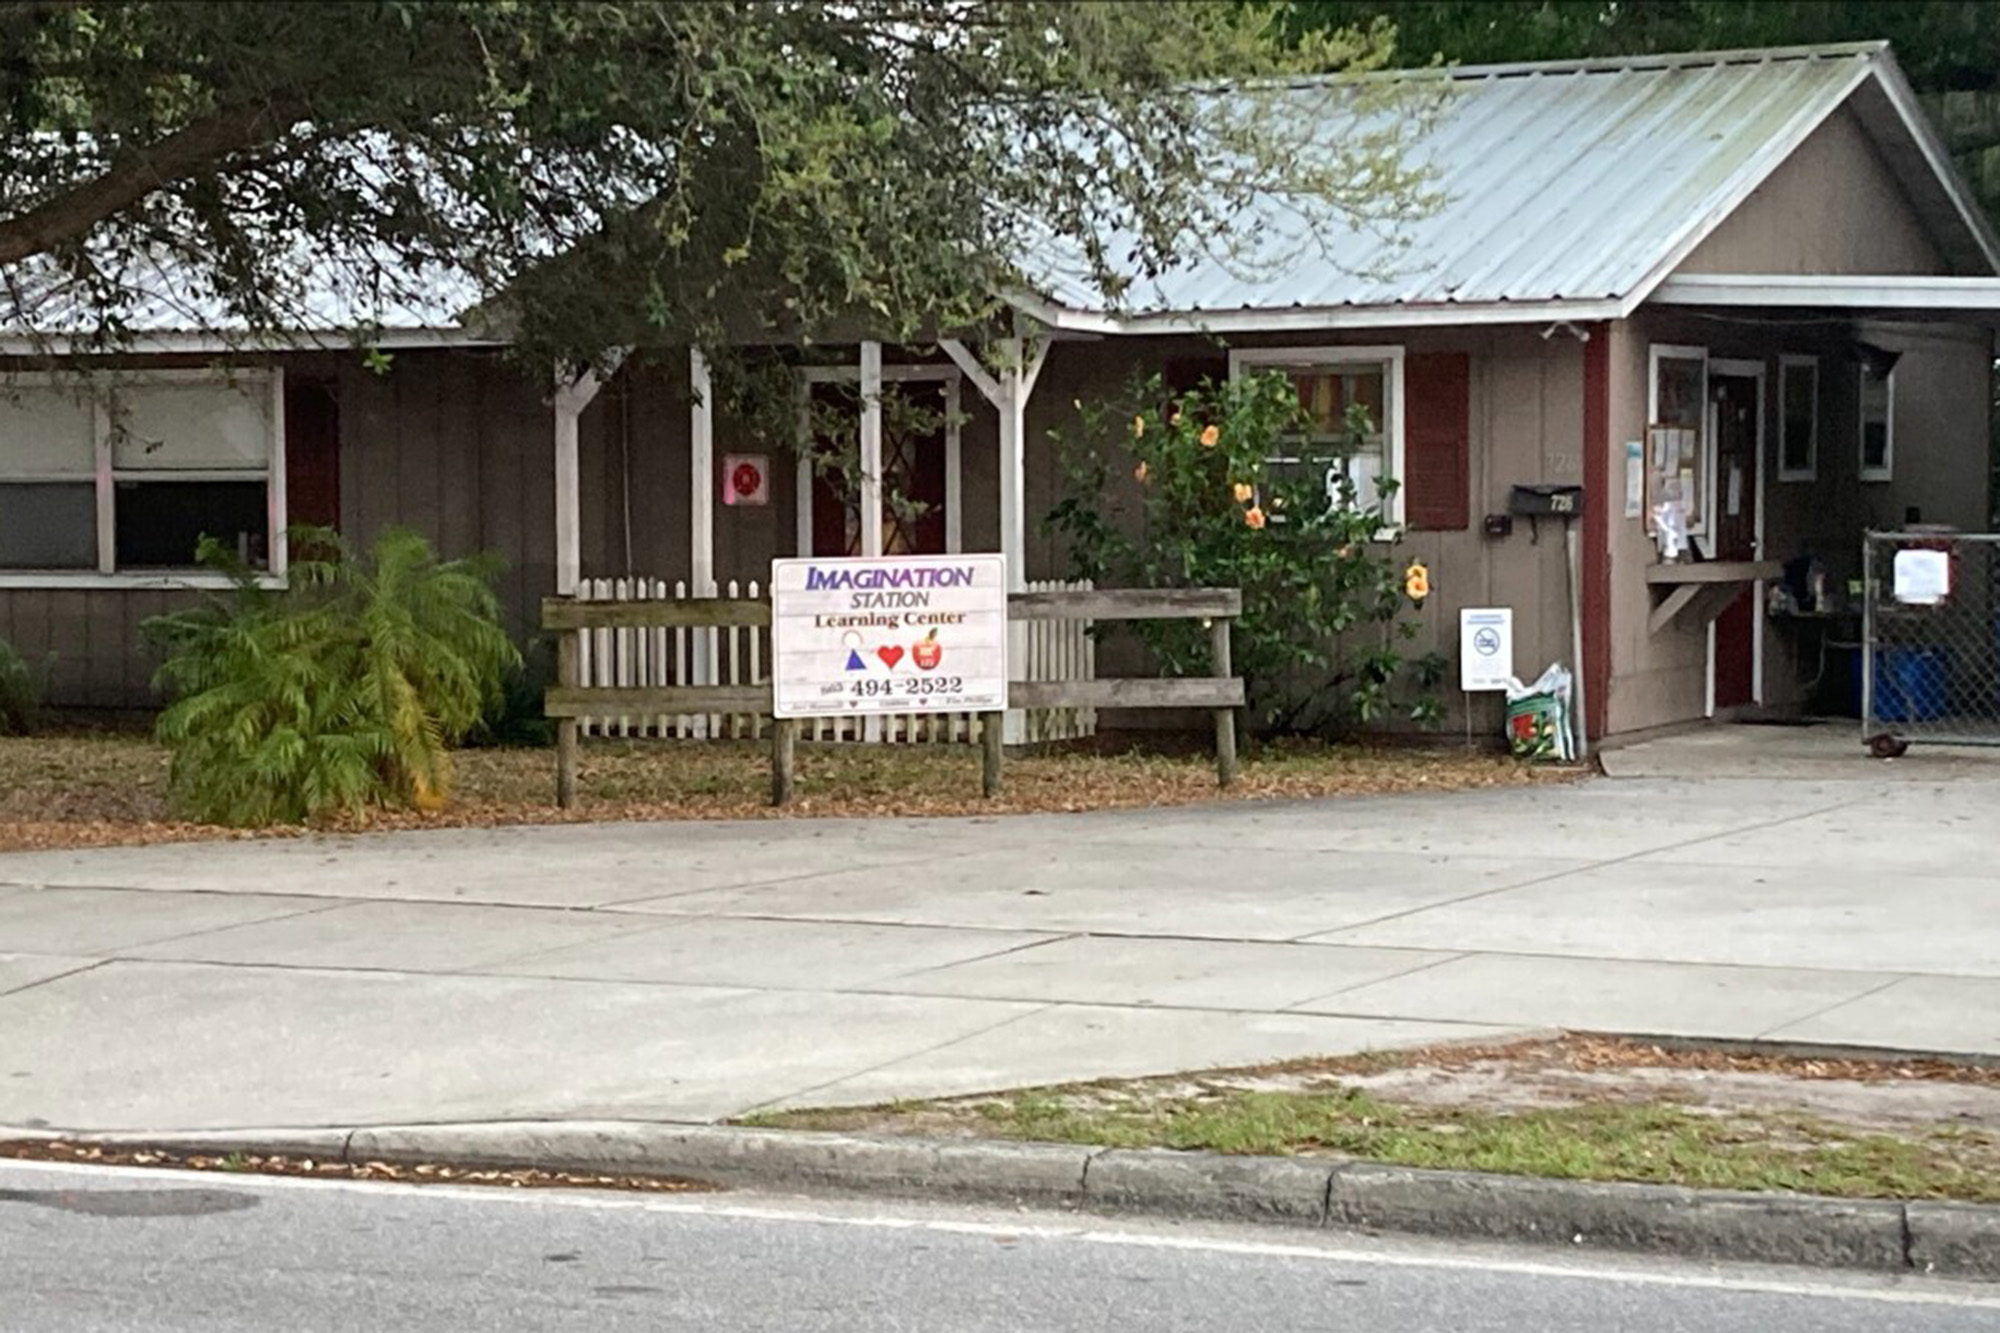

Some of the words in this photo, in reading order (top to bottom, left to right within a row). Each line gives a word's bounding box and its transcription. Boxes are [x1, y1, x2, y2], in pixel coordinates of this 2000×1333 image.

[1551, 494, 1573, 511] 726
[805, 566, 974, 591] IMAGINATION
[850, 591, 930, 609] STATION
[815, 613, 900, 629] Learning
[904, 611, 966, 626] Center
[850, 677, 963, 697] 494-2522
